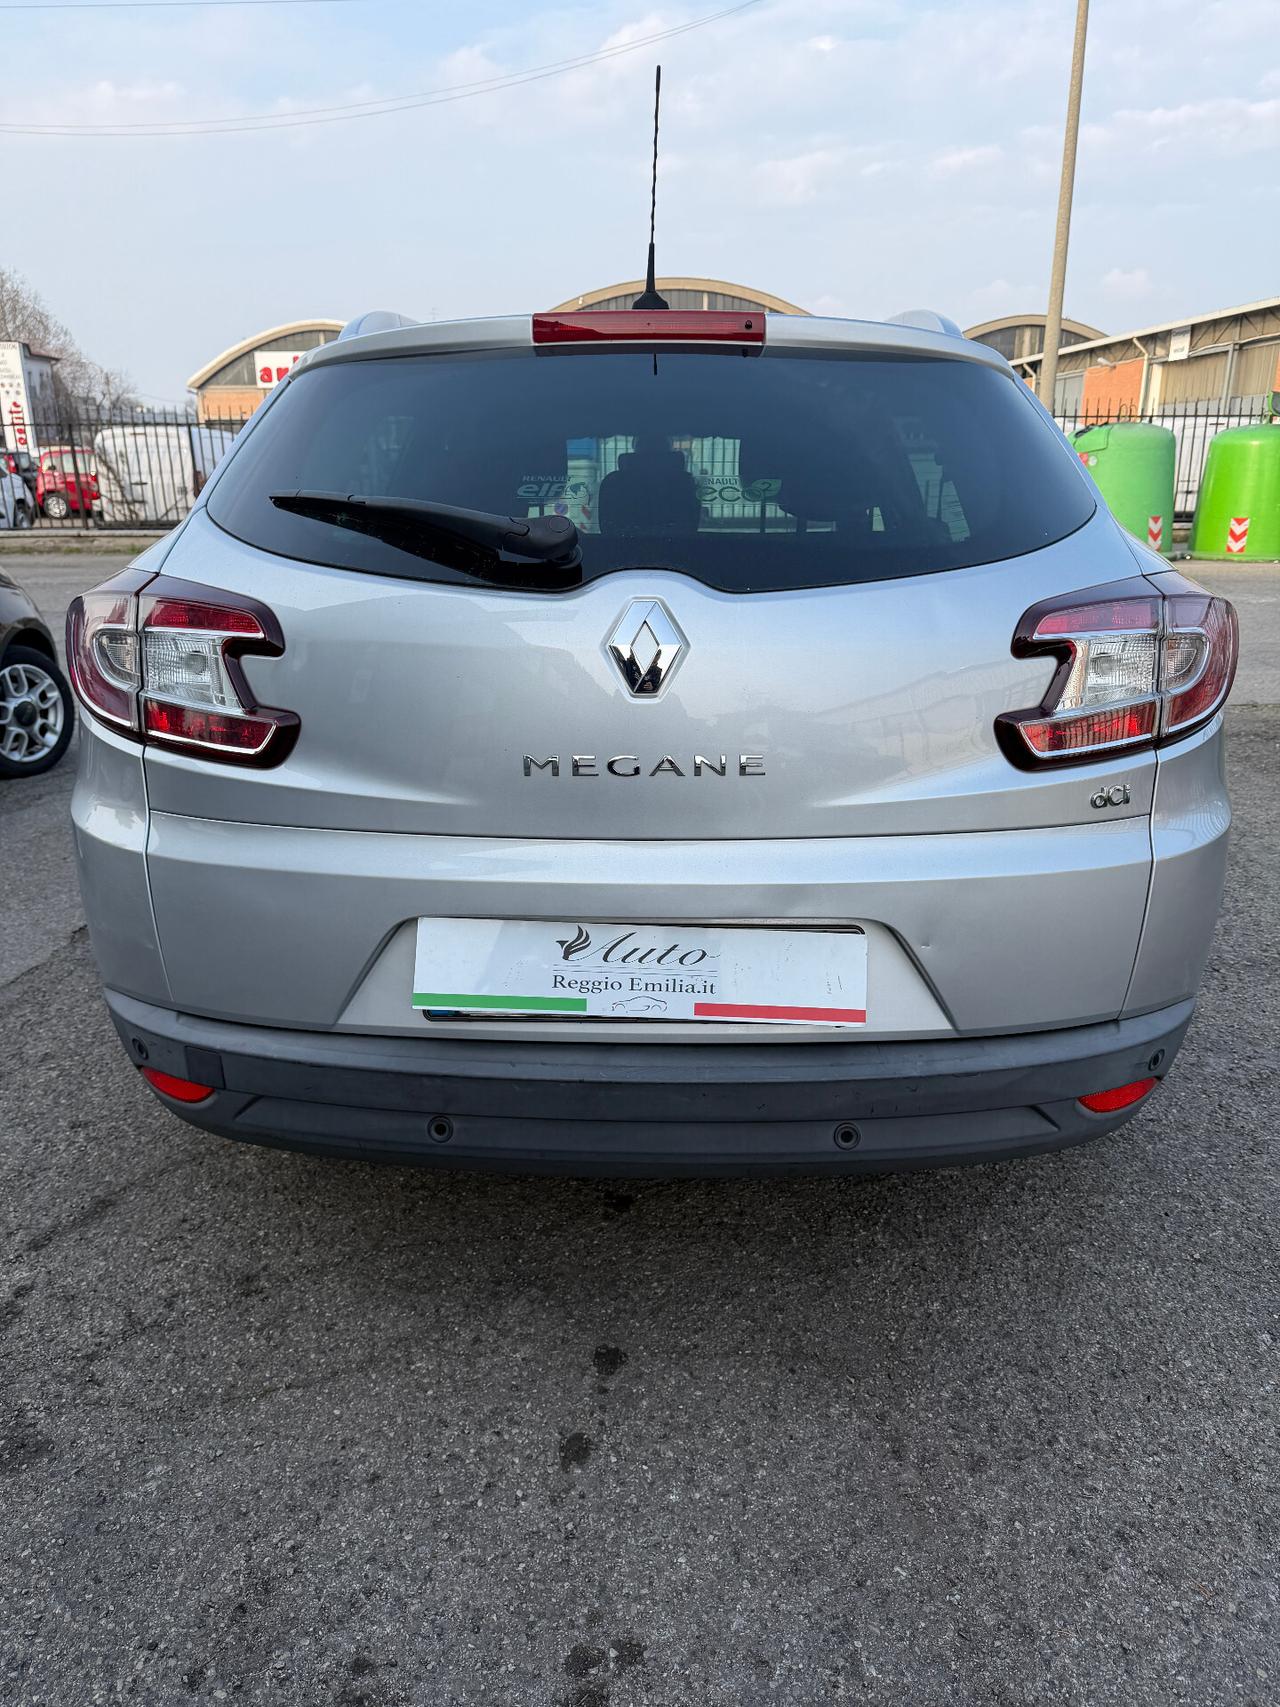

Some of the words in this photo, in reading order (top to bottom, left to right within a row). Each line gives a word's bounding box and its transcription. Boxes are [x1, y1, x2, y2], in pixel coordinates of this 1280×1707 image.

[523, 755, 766, 777] MEGANE
[1090, 785, 1130, 809] dCi
[566, 931, 721, 966] Auto
[551, 975, 622, 994] Reggio
[628, 977, 717, 995] Emilia.it
